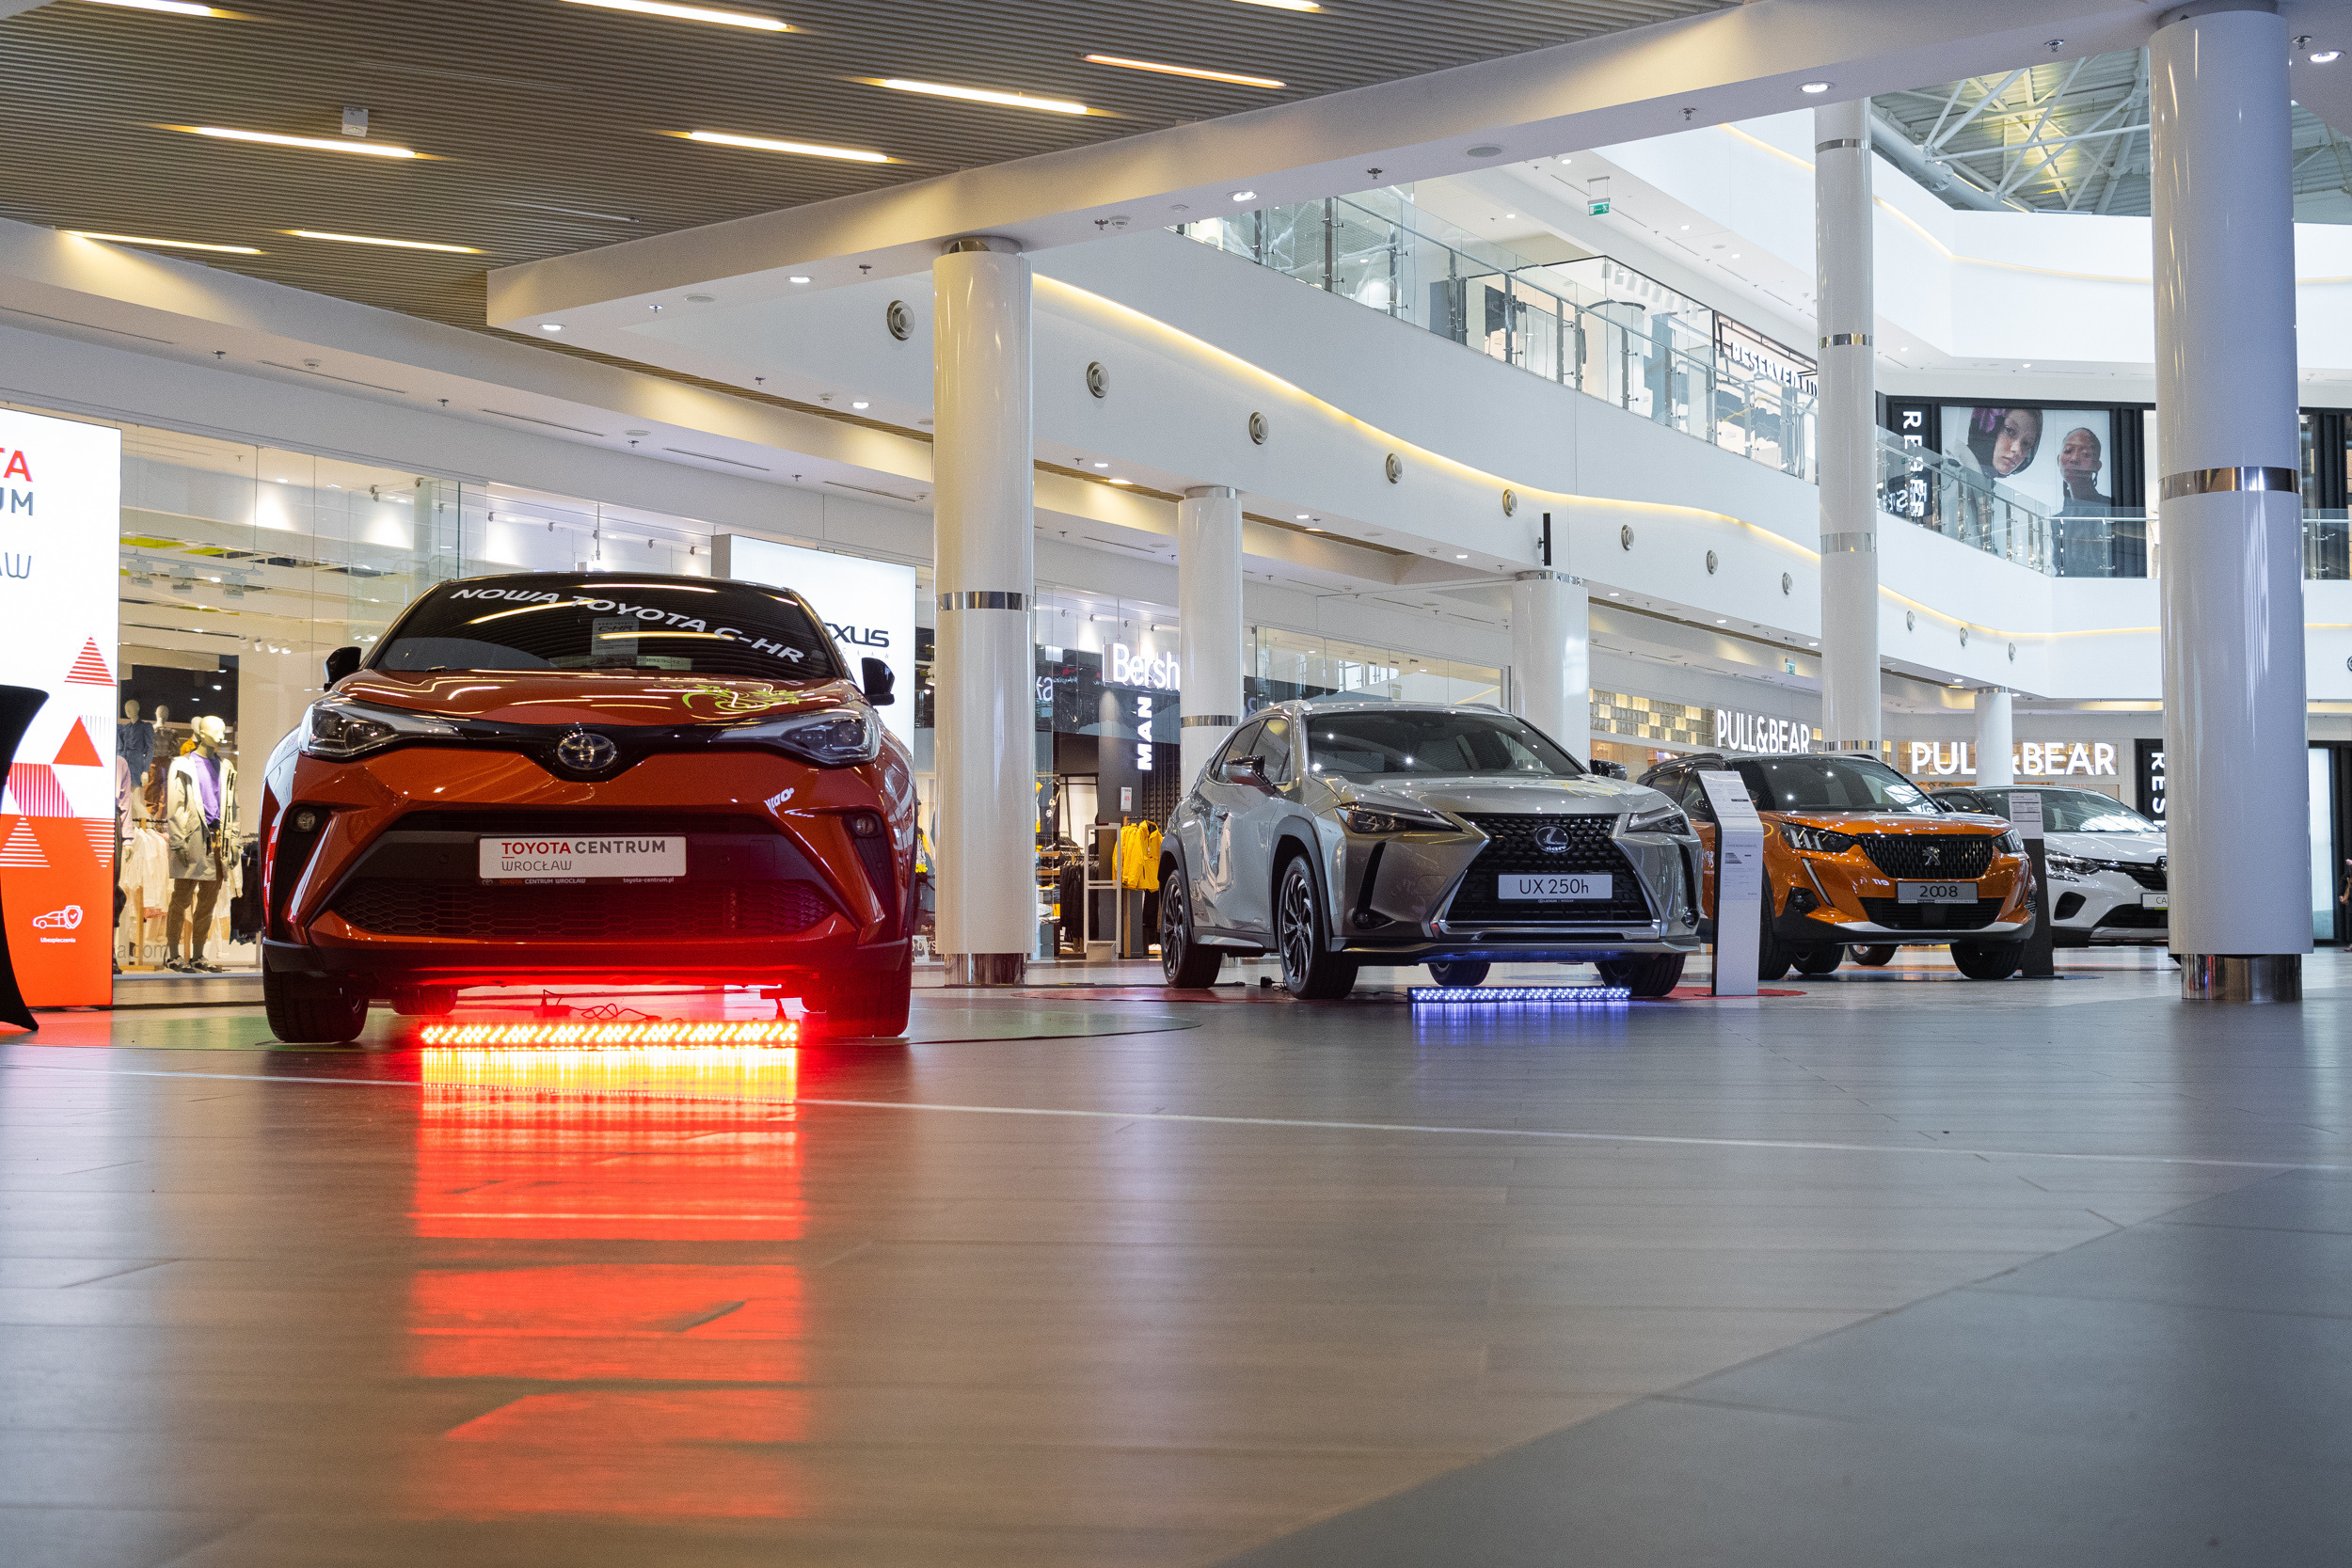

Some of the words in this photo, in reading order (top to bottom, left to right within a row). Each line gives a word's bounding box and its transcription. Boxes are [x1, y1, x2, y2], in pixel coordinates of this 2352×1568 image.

[450, 588, 561, 605] NOWA
[570, 594, 707, 633] TOYOTA
[713, 626, 805, 664] C-HR
[823, 622, 890, 648] XUS
[1113, 643, 1180, 691] Bersh
[1137, 696, 1152, 770] MAN
[1717, 709, 1810, 753] PULL&BEAR
[501, 841, 572, 855] TOYOTA
[575, 840, 666, 854] CENTRUM
[501, 860, 572, 872] WROCŁAW
[1519, 879, 1545, 895] UX
[1548, 879, 1589, 895] 250h
[1919, 885, 1958, 897] 2008
